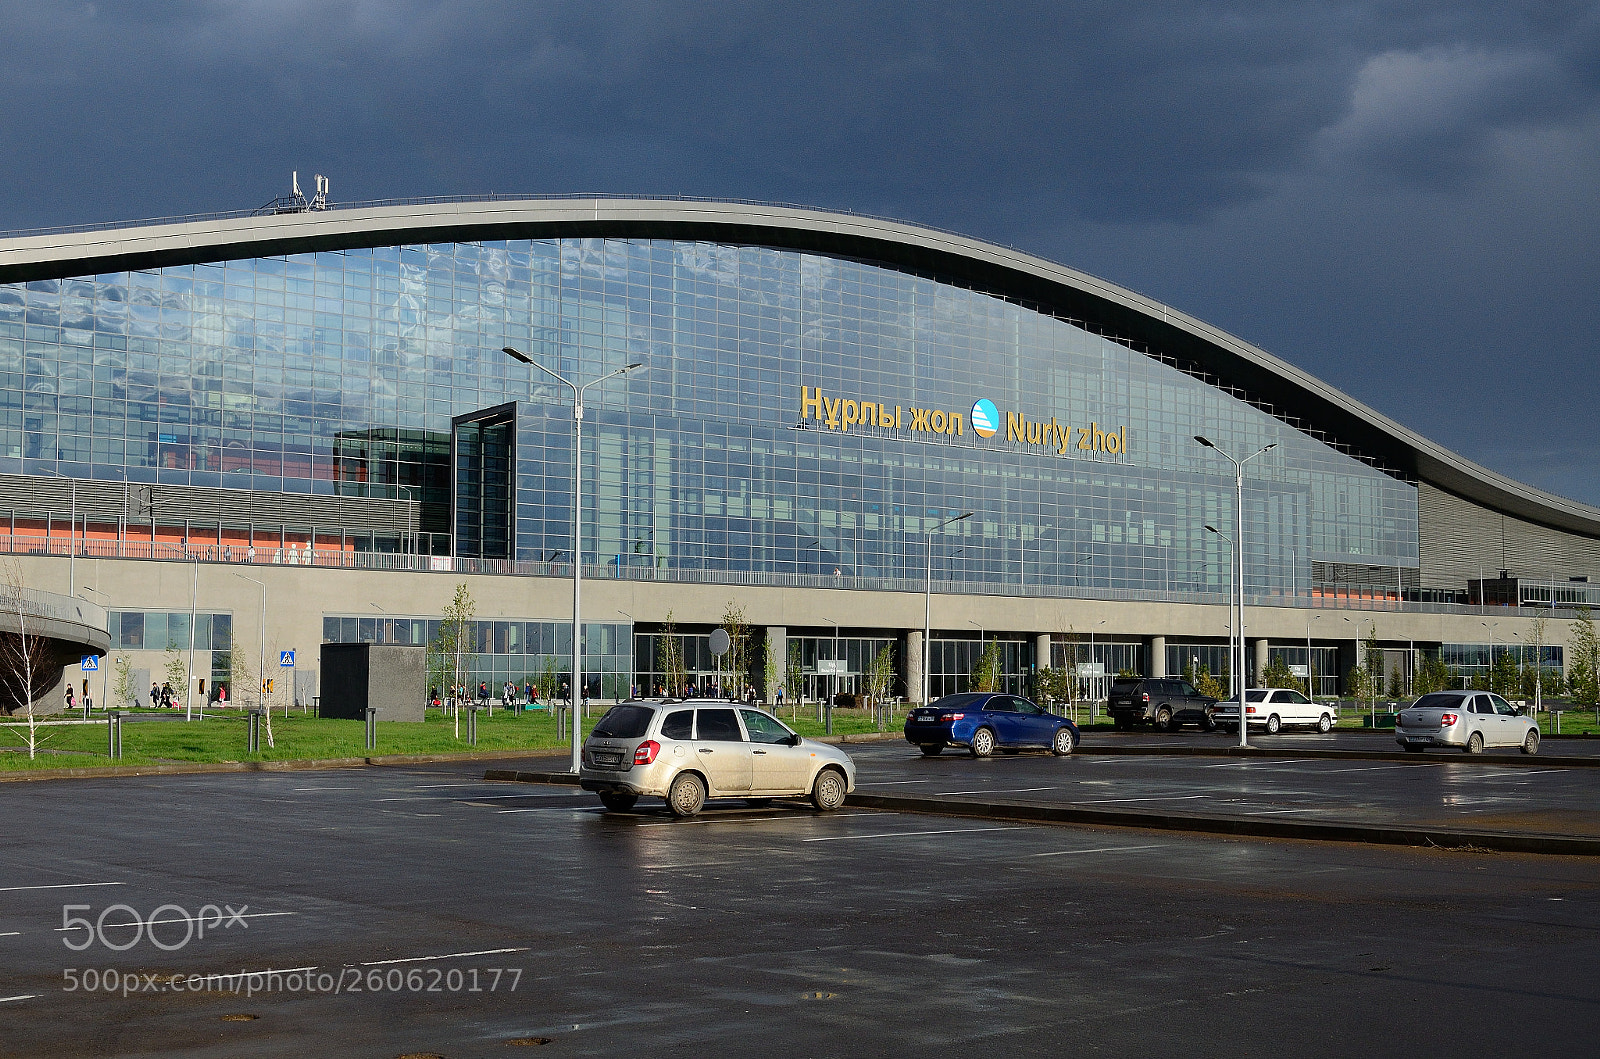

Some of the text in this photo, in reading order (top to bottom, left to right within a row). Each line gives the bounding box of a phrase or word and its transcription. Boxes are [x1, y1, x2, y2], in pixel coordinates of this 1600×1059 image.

[801, 385, 963, 435] Нұрлы жол
[1006, 411, 1127, 455] Nurly zhol
